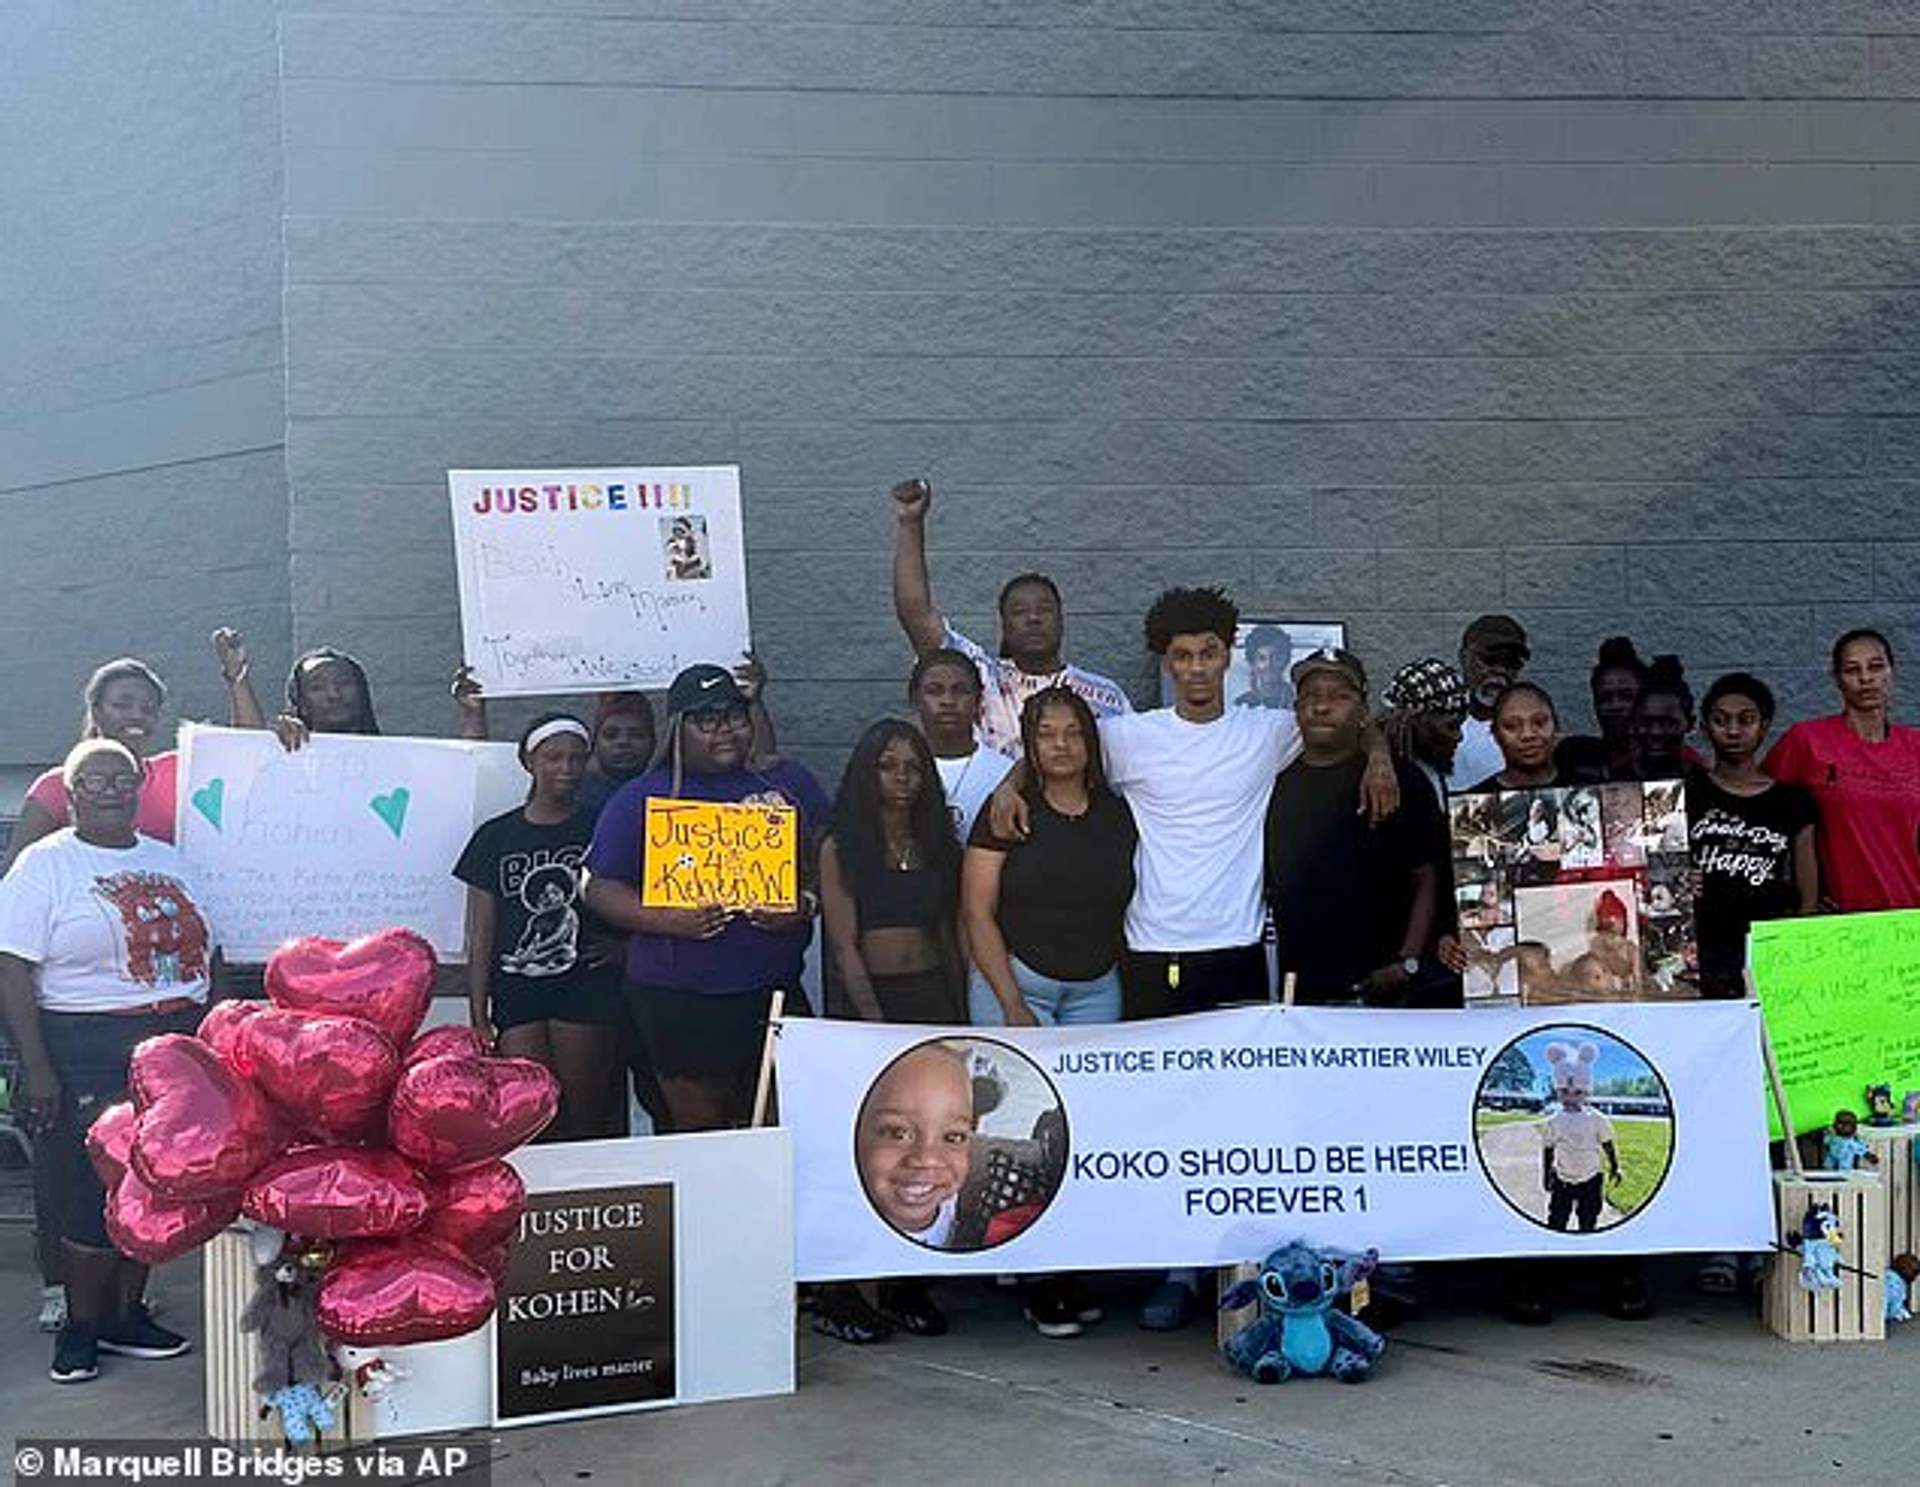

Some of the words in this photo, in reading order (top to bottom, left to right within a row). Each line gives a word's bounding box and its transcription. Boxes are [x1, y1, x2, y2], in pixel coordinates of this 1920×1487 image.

[474, 485, 627, 514] JUSTICE
[651, 806, 783, 850] Justice
[703, 850, 723, 883] 4
[1053, 1050, 1155, 1073] JUSTICE
[1163, 1049, 1215, 1070] FOR
[1221, 1048, 1308, 1069] KOHEN
[1311, 1047, 1410, 1068] KARTIER
[1415, 1046, 1487, 1068] WILEY
[1074, 1151, 1169, 1180] KOKO
[1180, 1148, 1316, 1176] SHOULD
[1327, 1147, 1367, 1173] BE
[1376, 1145, 1468, 1171] HERE!
[1186, 1187, 1345, 1216] FOREVER
[1354, 1186, 1368, 1212] 1
[517, 1202, 645, 1243] JUSTICE
[550, 1245, 615, 1274] FOR
[507, 1286, 623, 1322] KOHEN
[520, 1366, 560, 1388] Baby
[563, 1364, 598, 1381] lives
[602, 1359, 653, 1377] matter
